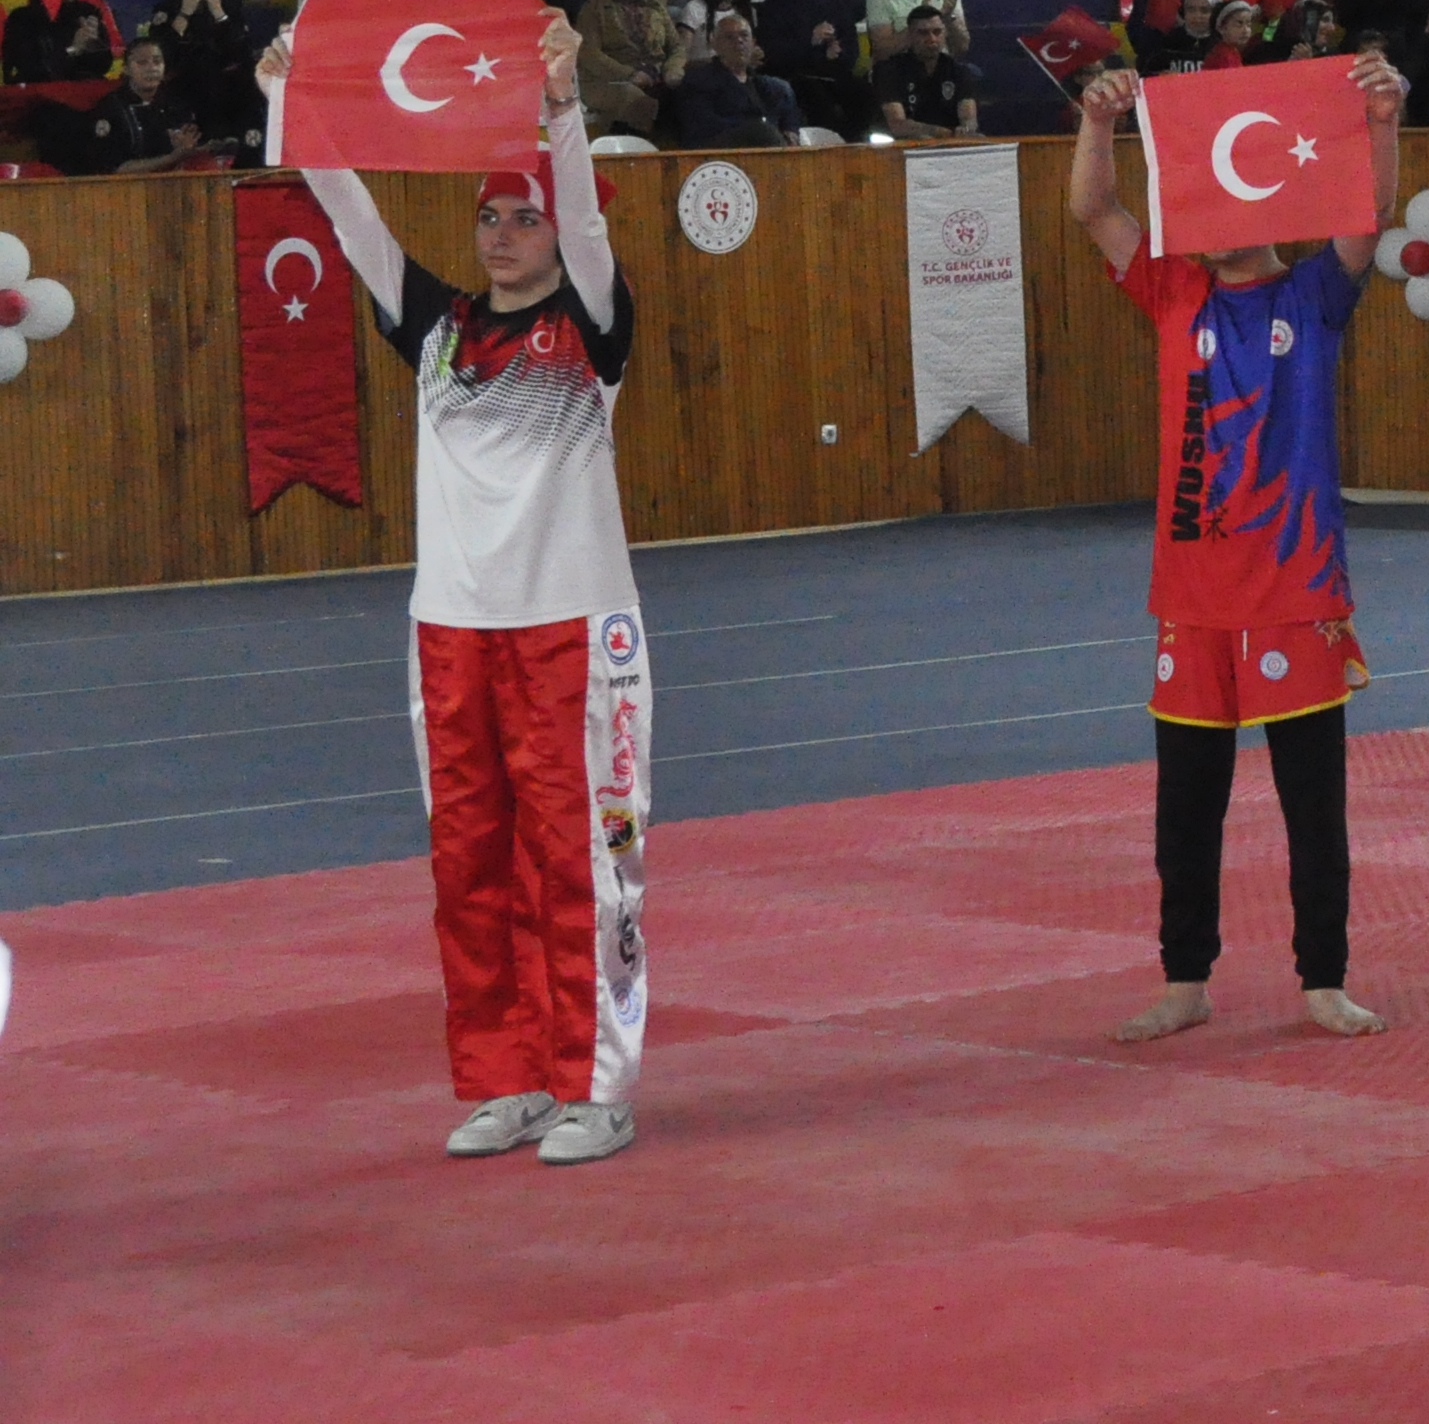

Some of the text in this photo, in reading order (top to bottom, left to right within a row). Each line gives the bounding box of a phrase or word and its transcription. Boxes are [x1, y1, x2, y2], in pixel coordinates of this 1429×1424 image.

[922, 257, 1013, 273] T.C. GENÇLİK VE
[923, 268, 1014, 286] SPOR BAKANLIĞI
[1171, 372, 1213, 542] WUSHU
